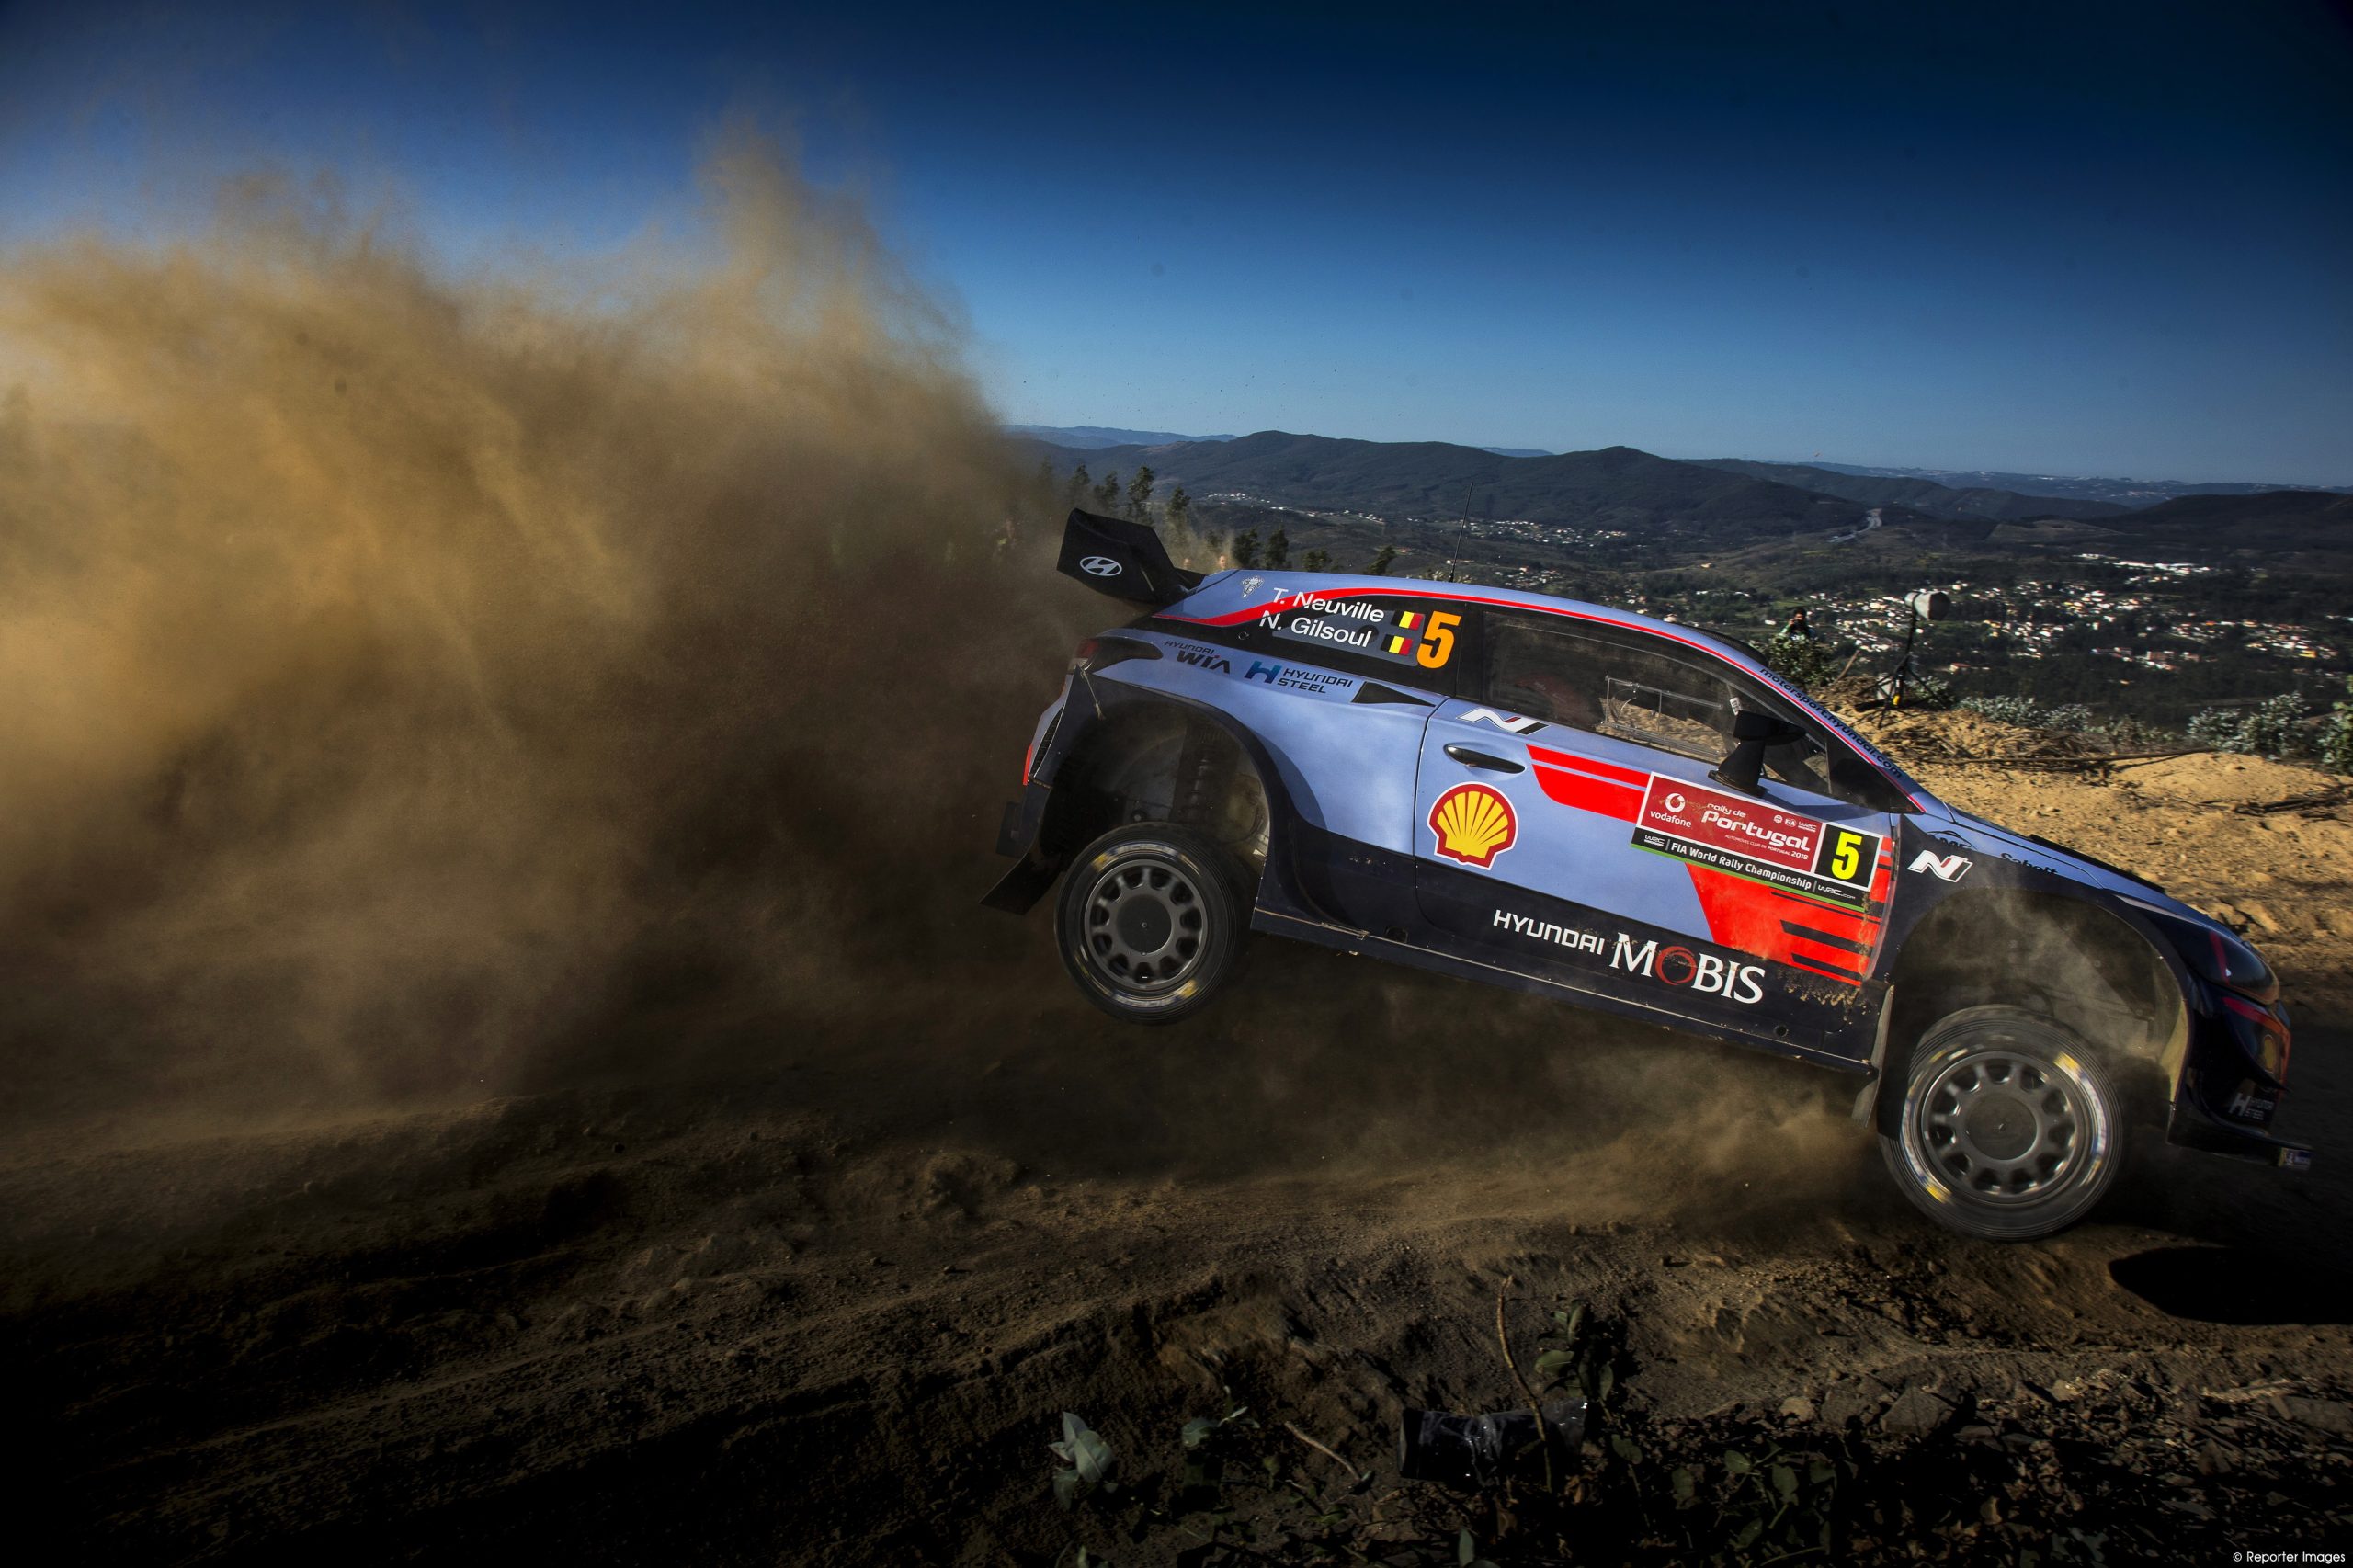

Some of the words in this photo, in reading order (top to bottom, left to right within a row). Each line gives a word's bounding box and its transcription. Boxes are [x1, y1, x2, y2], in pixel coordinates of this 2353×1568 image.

[1273, 587, 1289, 604] T.
[1292, 591, 1385, 623] Neuville
[1258, 609, 1282, 631] N.
[1290, 617, 1372, 648] Gilsoul
[1416, 610, 1462, 669] 5
[1165, 640, 1215, 655] HYUNDAI
[1176, 650, 1231, 675] WIA
[1277, 678, 1326, 694] STEEL
[1283, 668, 1353, 688] HYUNDAI
[1759, 667, 1902, 778] motorsport.hyundai.com
[1650, 810, 1692, 828] vodafone
[1707, 803, 1732, 815] rally
[1733, 810, 1746, 818] de
[1701, 810, 1811, 852] Portugal
[1671, 842, 1687, 855] FIA
[1689, 847, 1717, 862] World
[1719, 856, 1743, 871] Rally
[1745, 863, 1812, 891] Championship
[1790, 850, 1808, 860] 2018
[1831, 831, 1862, 880] 5
[1493, 909, 1606, 955] HYUNDAI
[1609, 932, 1766, 1005] MOBIS
